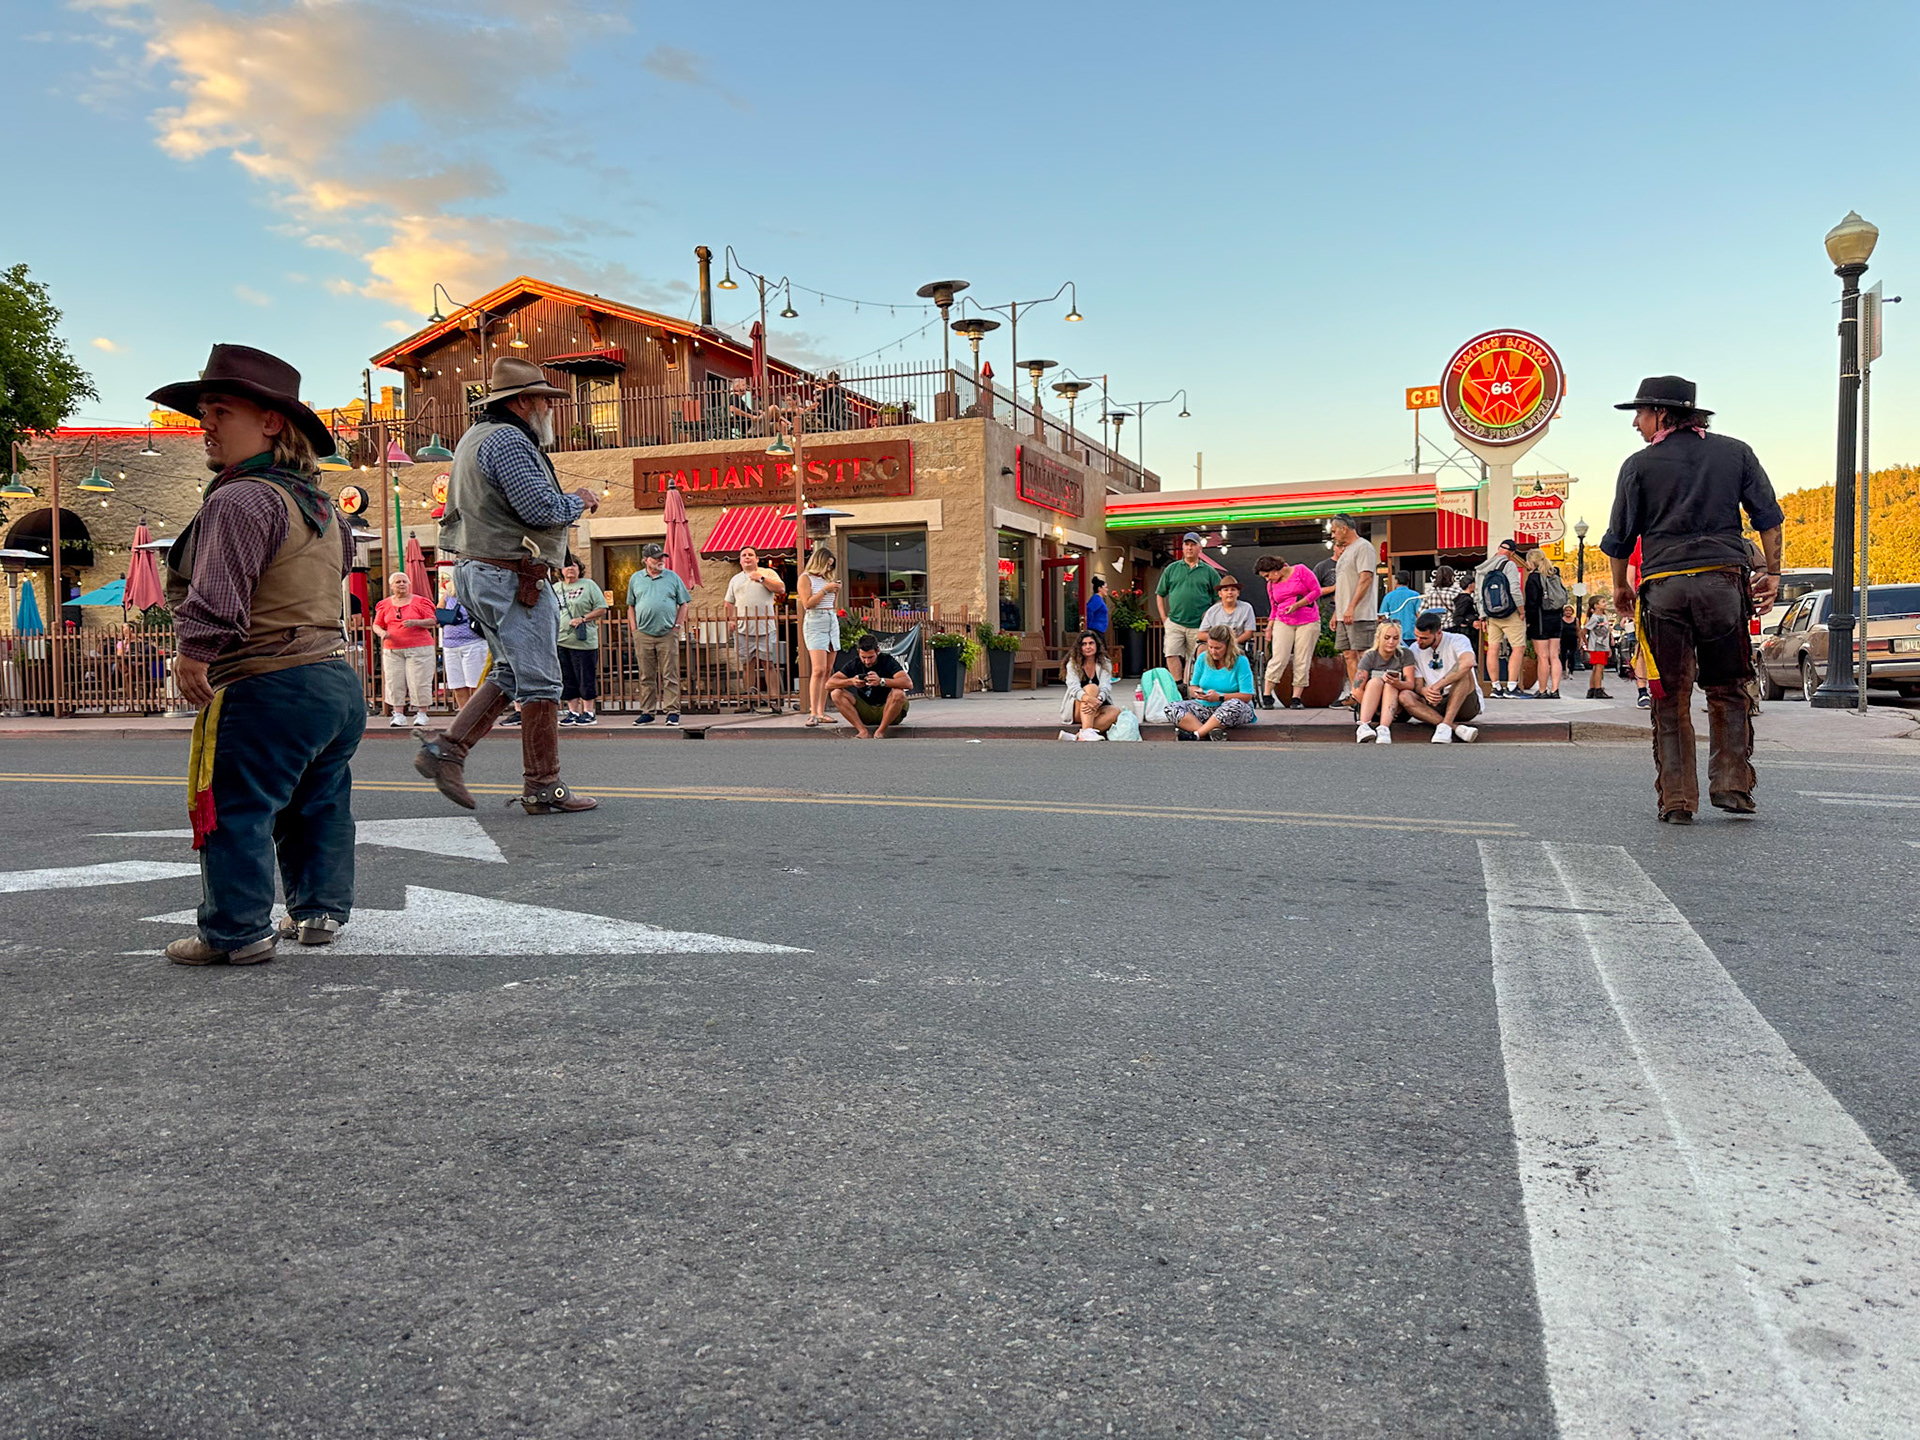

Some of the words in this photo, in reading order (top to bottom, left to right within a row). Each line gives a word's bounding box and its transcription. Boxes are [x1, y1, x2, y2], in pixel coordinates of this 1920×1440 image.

[1506, 337, 1551, 367] BISTRO
[1491, 381, 1513, 395] 66
[1526, 399, 1553, 429] PIZZA
[642, 464, 765, 494] ITALIAN
[775, 456, 900, 487] BSTRO
[768, 488, 797, 497] FIRE
[1518, 500, 1545, 508] STATION
[1519, 511, 1554, 520] PIZZA
[1519, 522, 1554, 530] PASTA
